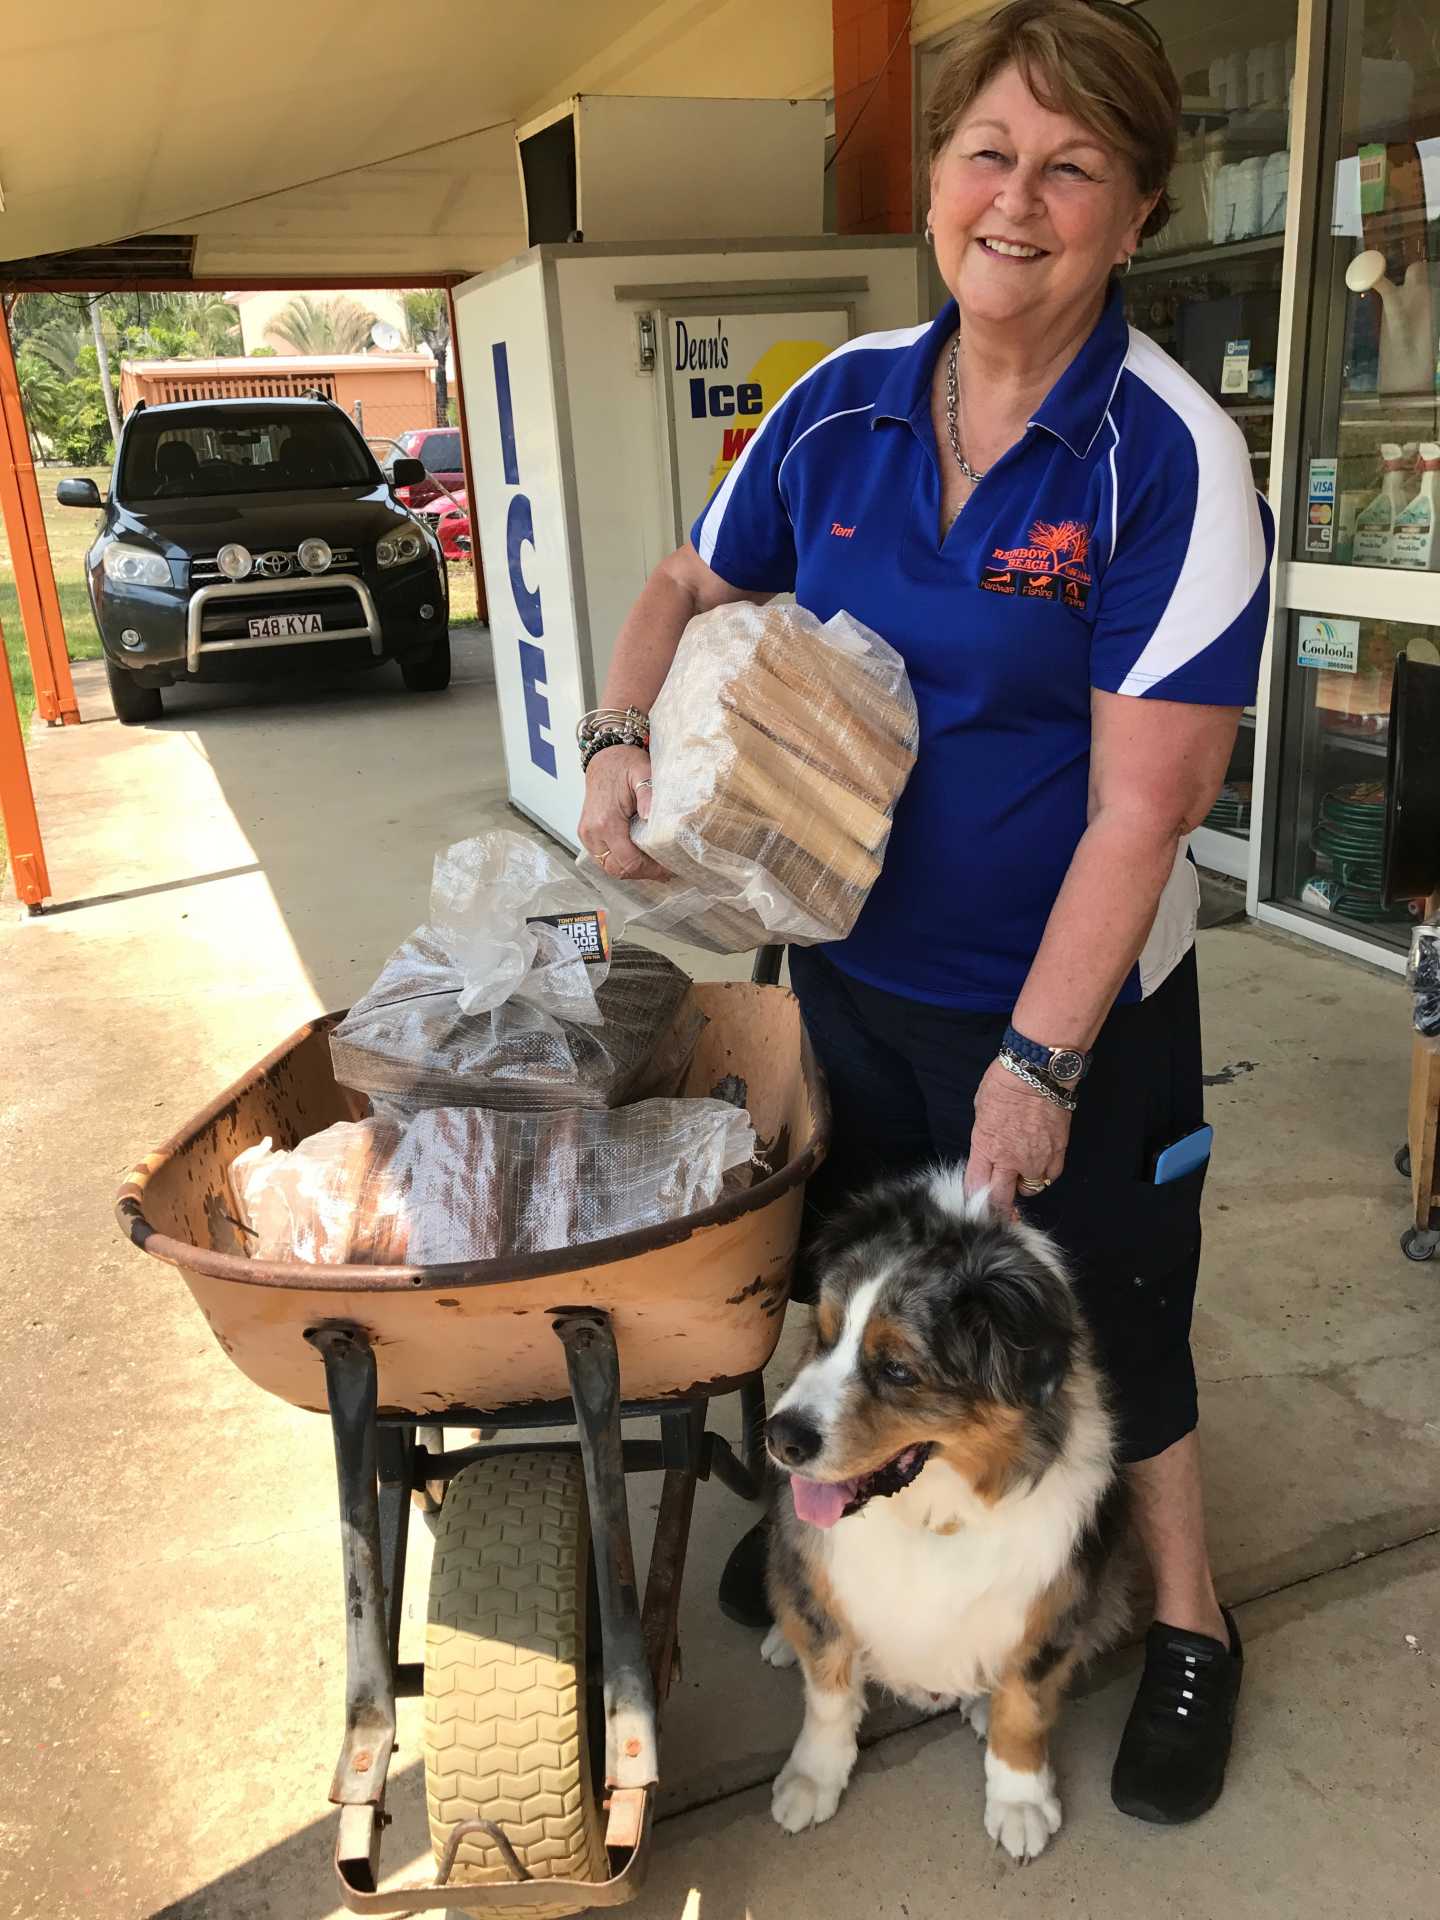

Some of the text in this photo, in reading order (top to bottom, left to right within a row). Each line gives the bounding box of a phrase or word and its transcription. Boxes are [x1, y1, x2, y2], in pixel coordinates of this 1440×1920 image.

[675, 318, 729, 371] Dean's
[689, 378, 763, 419] Ice
[1312, 481, 1334, 493] VISA
[492, 341, 557, 779] ICE
[991, 548, 1051, 561] RAINBOW
[1007, 558, 1050, 570] BEACH
[1022, 585, 1053, 599] Fishing
[286, 616, 320, 634] KYA
[1302, 639, 1353, 659] Cooloola
